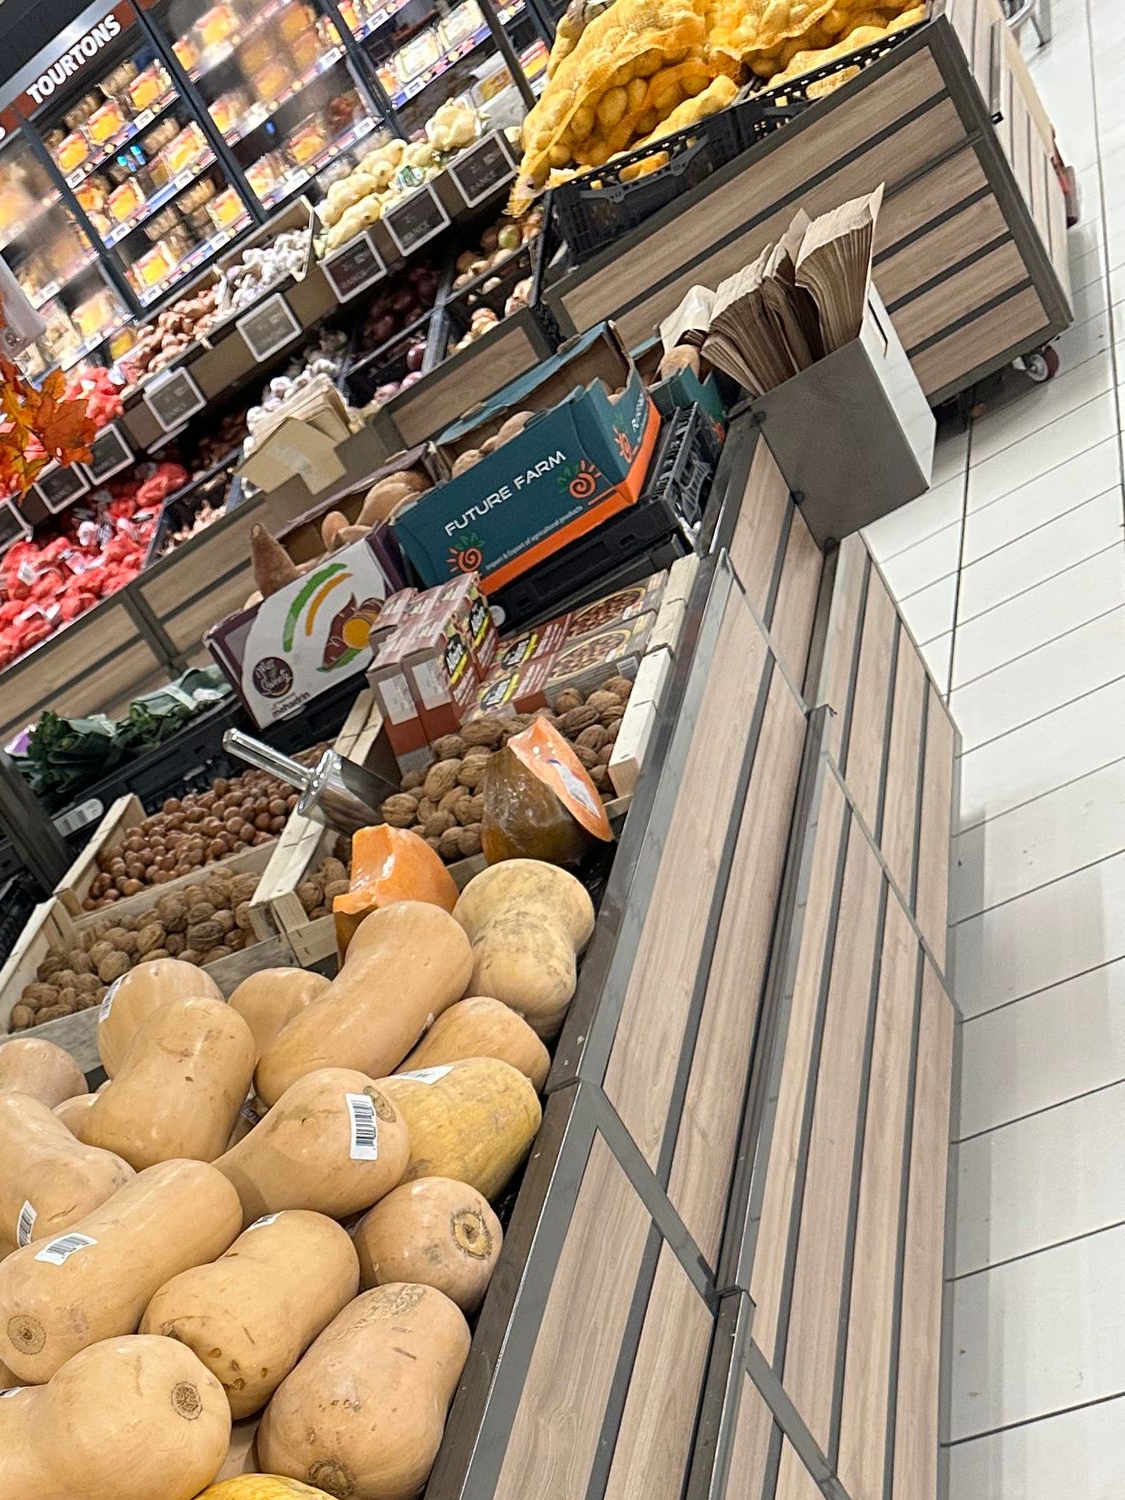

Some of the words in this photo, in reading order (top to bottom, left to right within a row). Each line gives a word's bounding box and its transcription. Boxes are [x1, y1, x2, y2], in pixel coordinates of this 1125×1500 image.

[26, 13, 122, 105] TOURTONS
[444, 485, 513, 537] FUTURE
[513, 450, 567, 490] FARM
[559, 505, 584, 525] products
